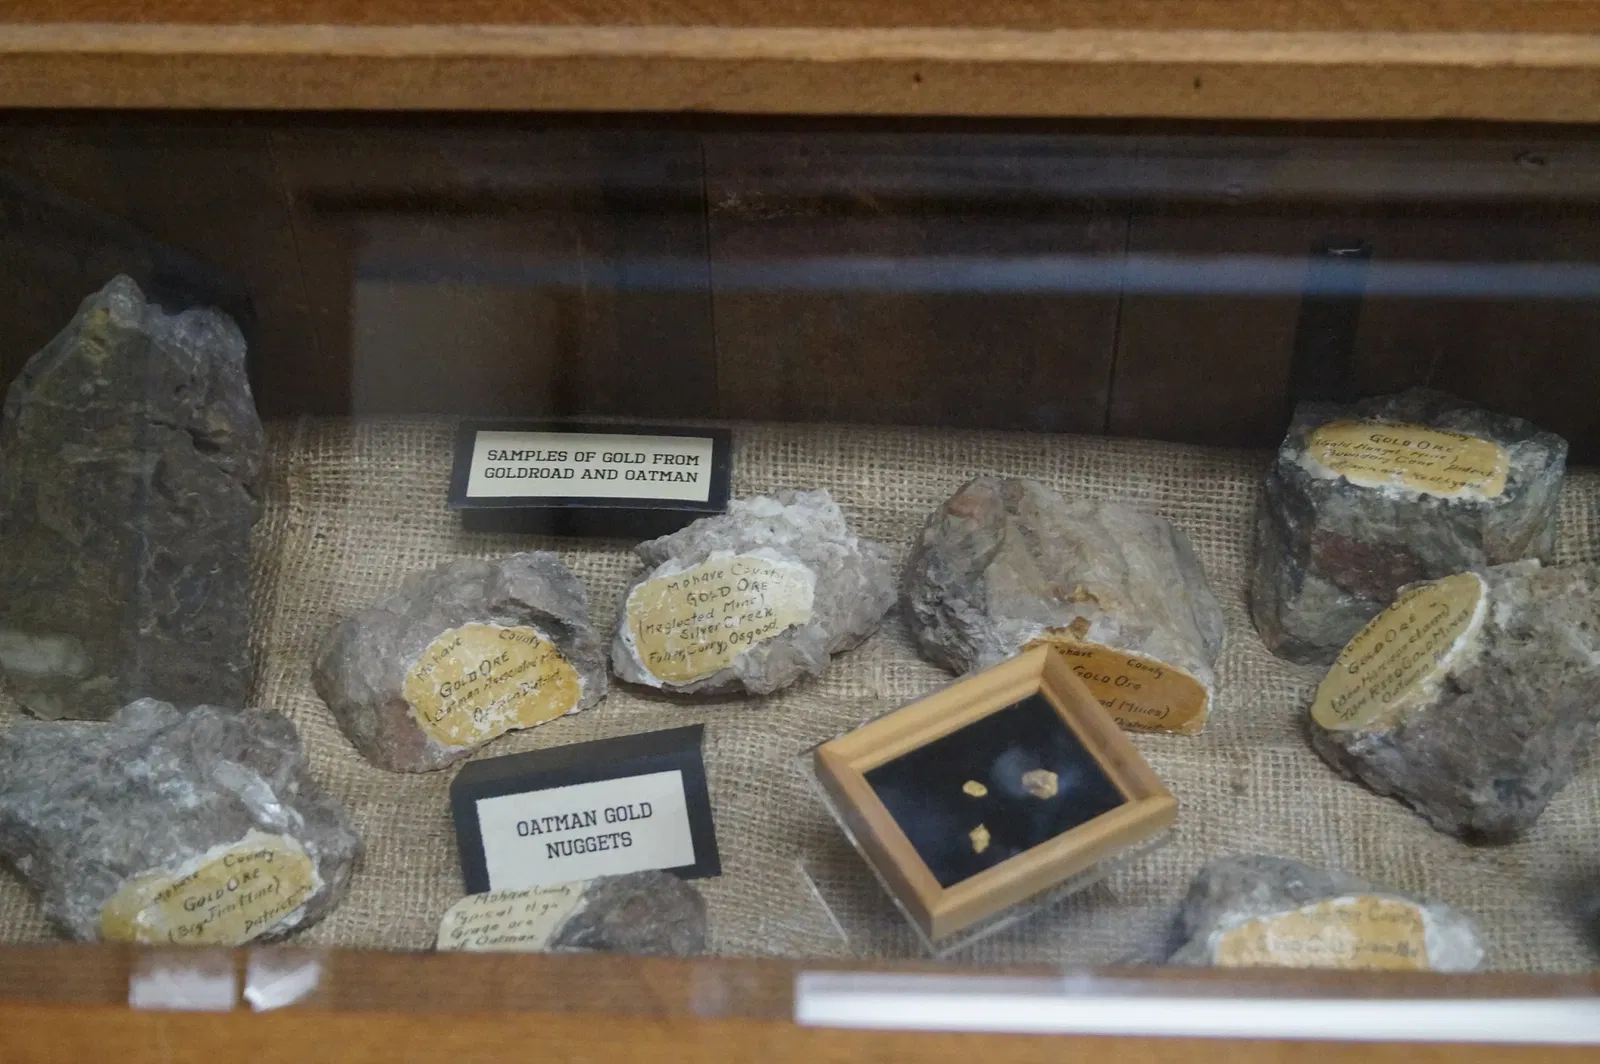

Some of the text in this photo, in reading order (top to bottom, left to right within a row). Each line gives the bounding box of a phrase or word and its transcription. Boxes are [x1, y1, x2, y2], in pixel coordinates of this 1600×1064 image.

[1369, 433, 1410, 447] GOLD
[487, 449, 700, 466] SAMPLES OF GOLD FROM
[484, 467, 699, 483] GOLDROAD AND OATMAN
[686, 577, 769, 607] GOLD ORE
[498, 629, 541, 649] County
[439, 670, 478, 699] GOLD
[479, 650, 510, 676] ORE
[516, 801, 653, 838] OATMAN GOLD
[545, 831, 633, 860] NUGGETS
[183, 888, 224, 912] GOLD
